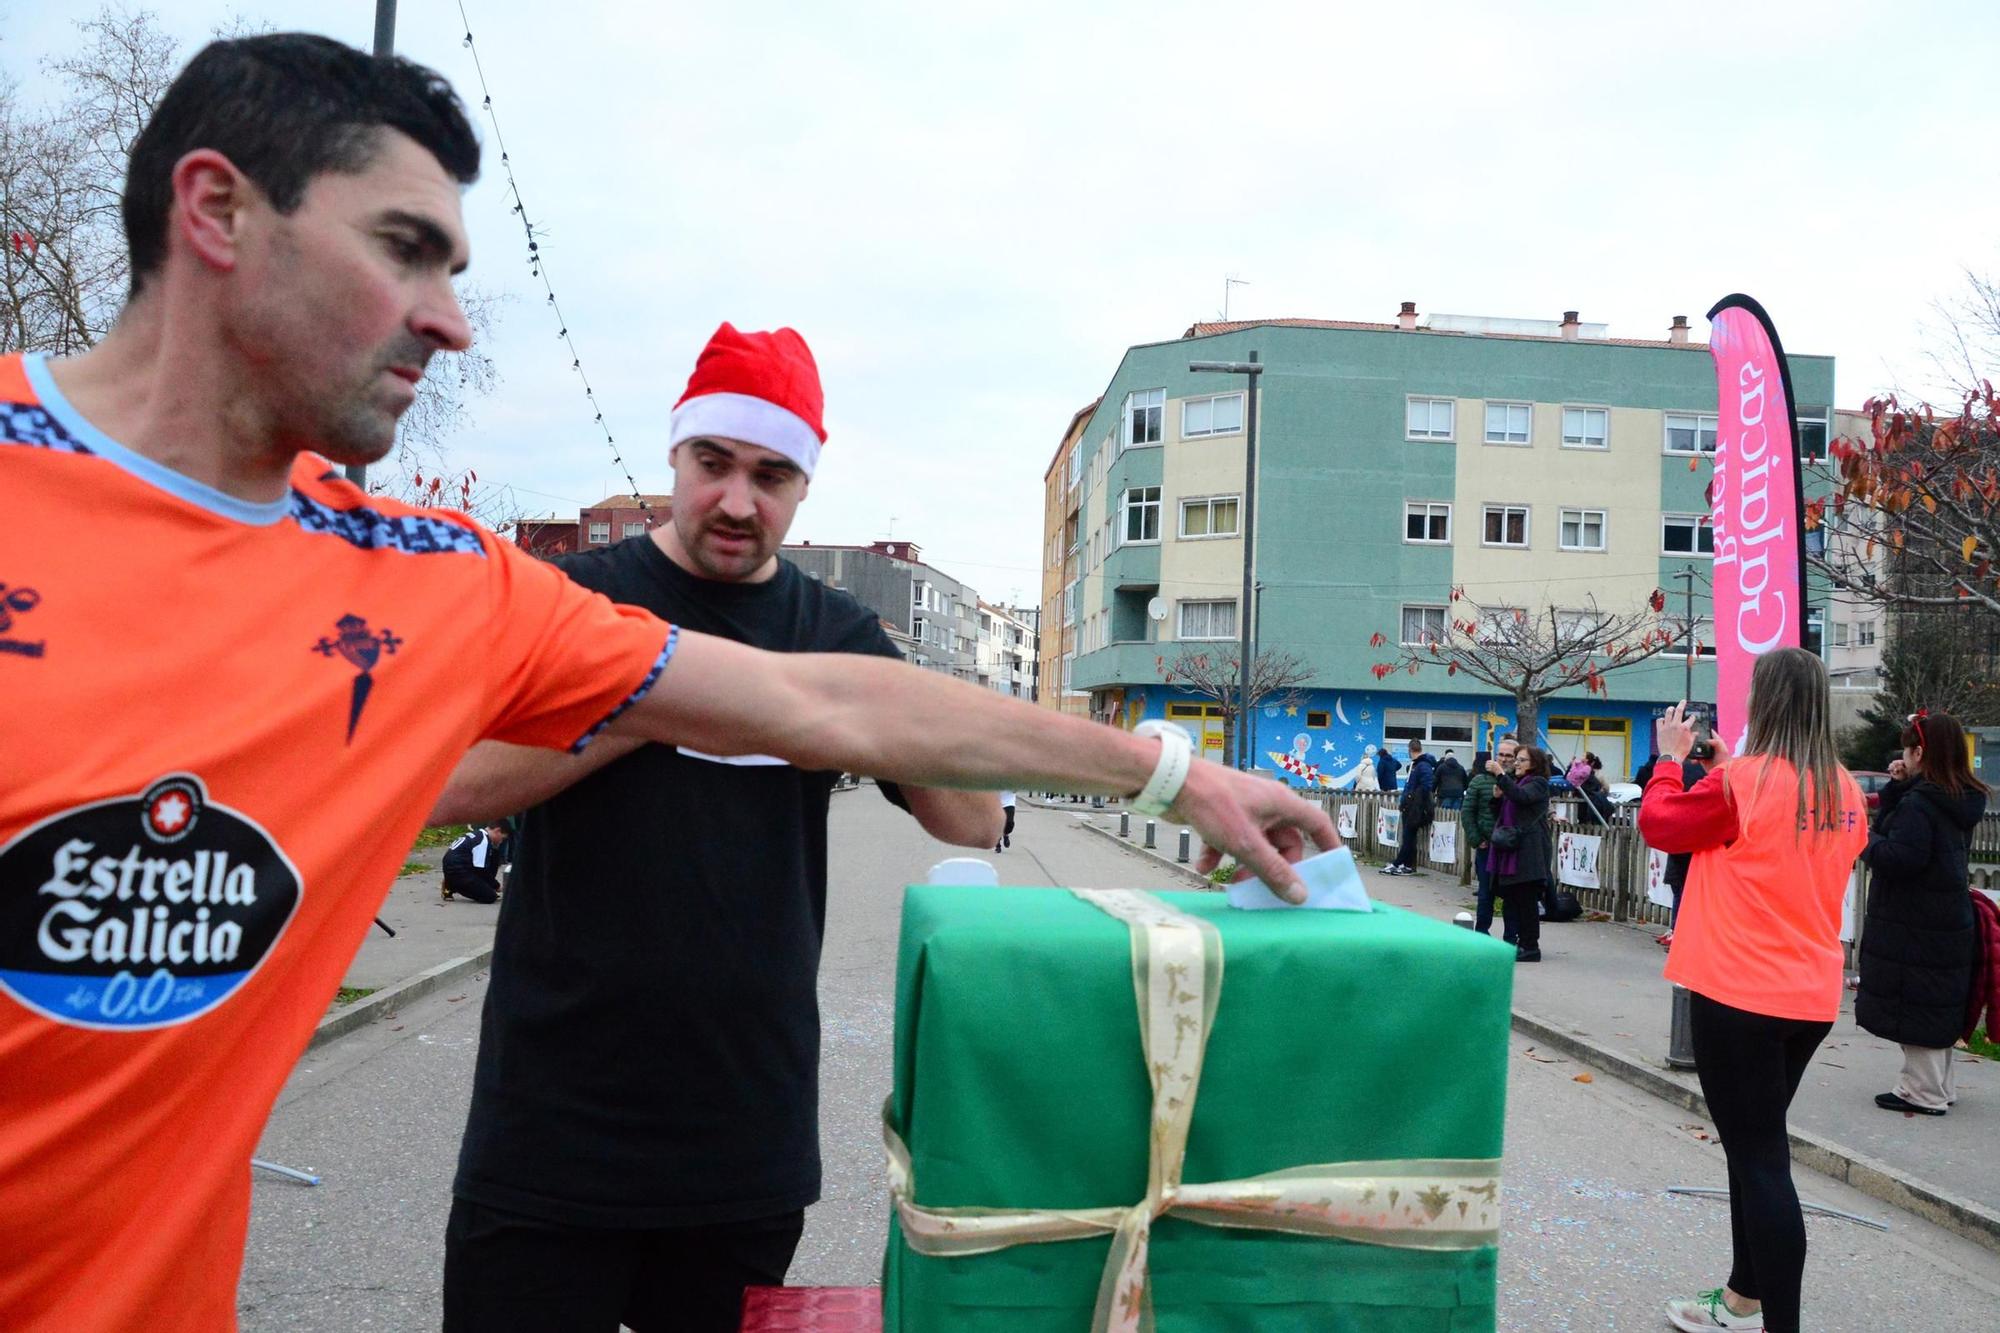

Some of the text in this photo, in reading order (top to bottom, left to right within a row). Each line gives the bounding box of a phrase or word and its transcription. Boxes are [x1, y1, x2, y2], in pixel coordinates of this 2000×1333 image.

[38, 838, 258, 906] Estrella
[37, 899, 243, 965] Galicia
[100, 968, 176, 1019] 0,0
